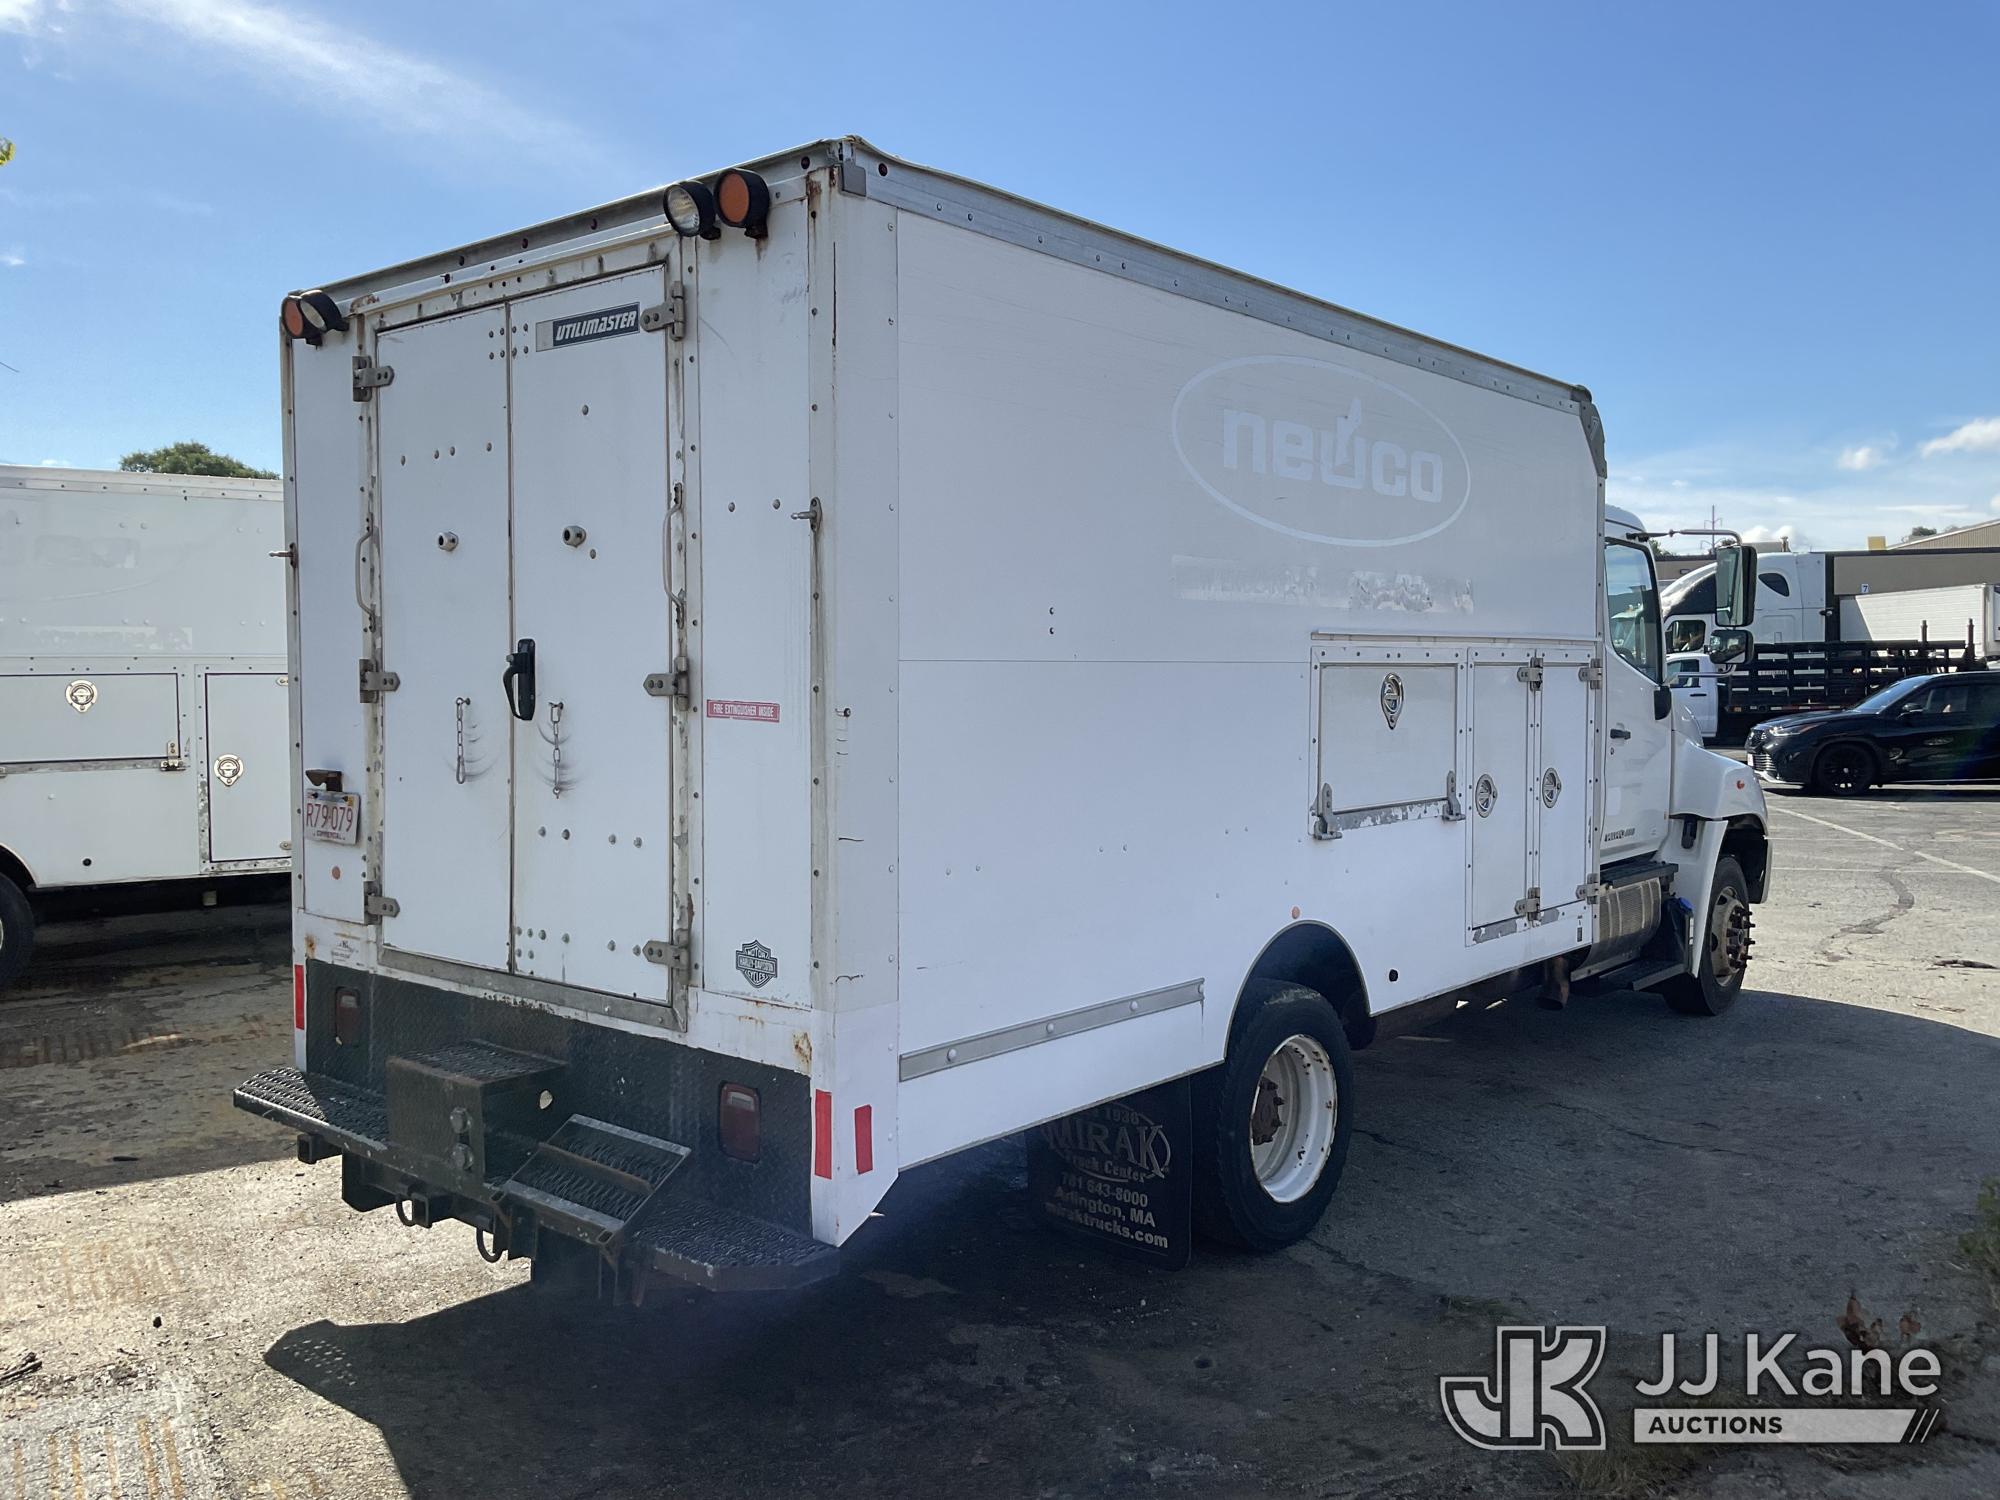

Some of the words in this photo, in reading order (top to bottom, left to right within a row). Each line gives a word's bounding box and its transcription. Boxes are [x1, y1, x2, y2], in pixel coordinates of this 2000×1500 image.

[555, 310, 637, 341] UTILIMASTER
[1222, 397, 1443, 503] neuco
[713, 703, 724, 714] FIRE
[725, 704, 756, 716] EXTINGUISHER
[758, 706, 774, 717] INSIDE
[1104, 1160, 1147, 1184] Center
[1054, 1186, 1126, 1223] Arlington,
[1129, 1207, 1157, 1229] MA
[1087, 1179, 1149, 1208] 643-8000
[1042, 1201, 1169, 1249] miraktrucks.com
